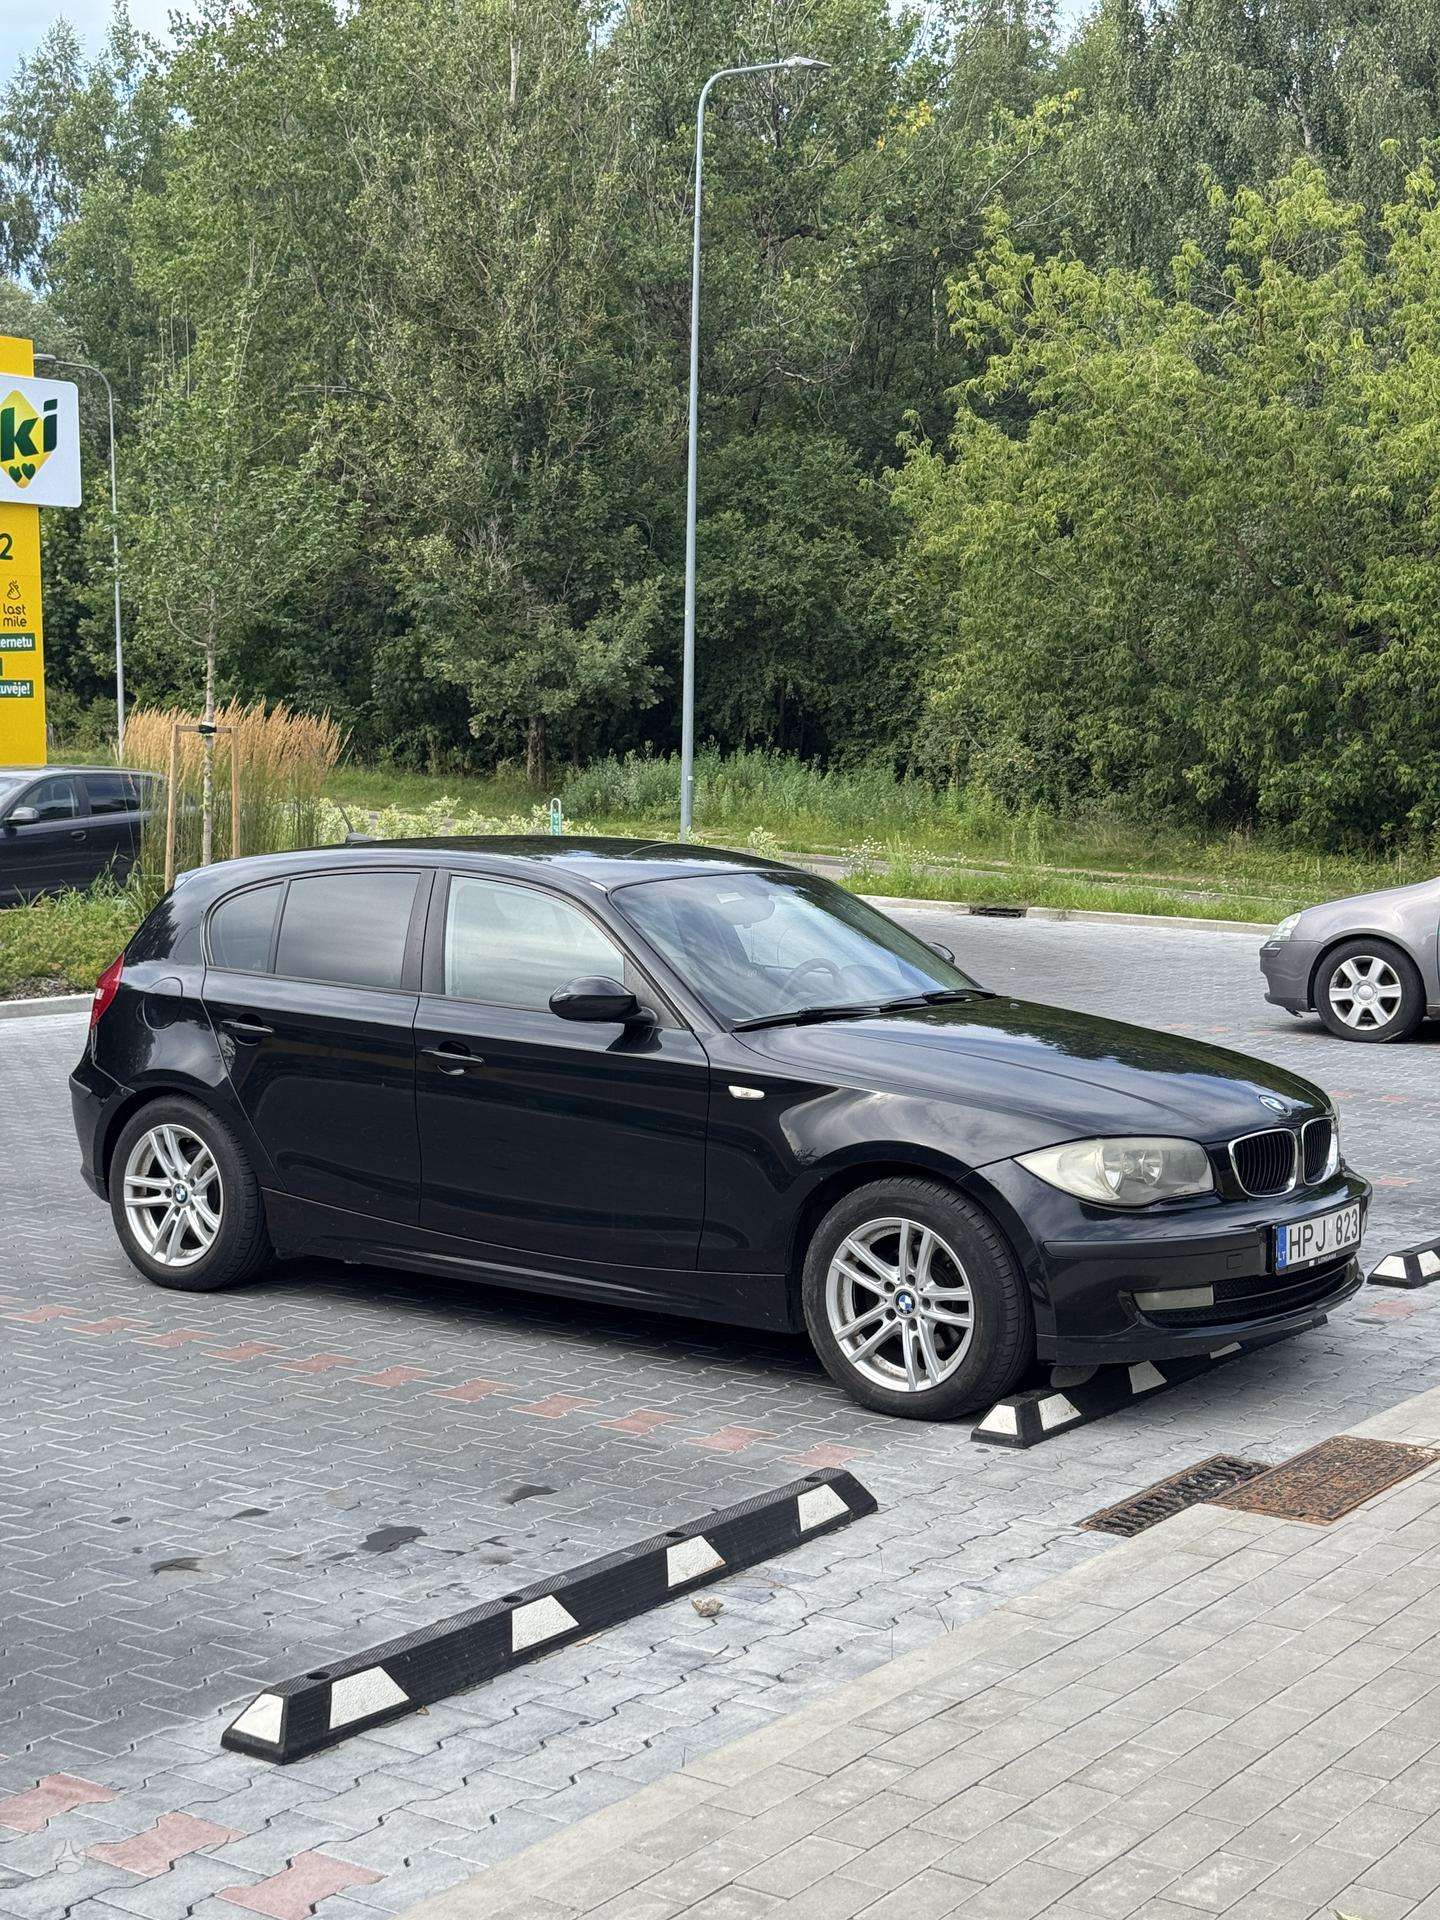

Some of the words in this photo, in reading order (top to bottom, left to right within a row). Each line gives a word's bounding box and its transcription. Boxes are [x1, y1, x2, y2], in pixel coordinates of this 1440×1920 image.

[0, 398, 58, 463] ki
[3, 603, 26, 616] last
[3, 616, 27, 628] mile
[0, 636, 33, 648] ernetu
[1289, 1220, 1326, 1260] HPJ
[1336, 1208, 1358, 1245] 823
